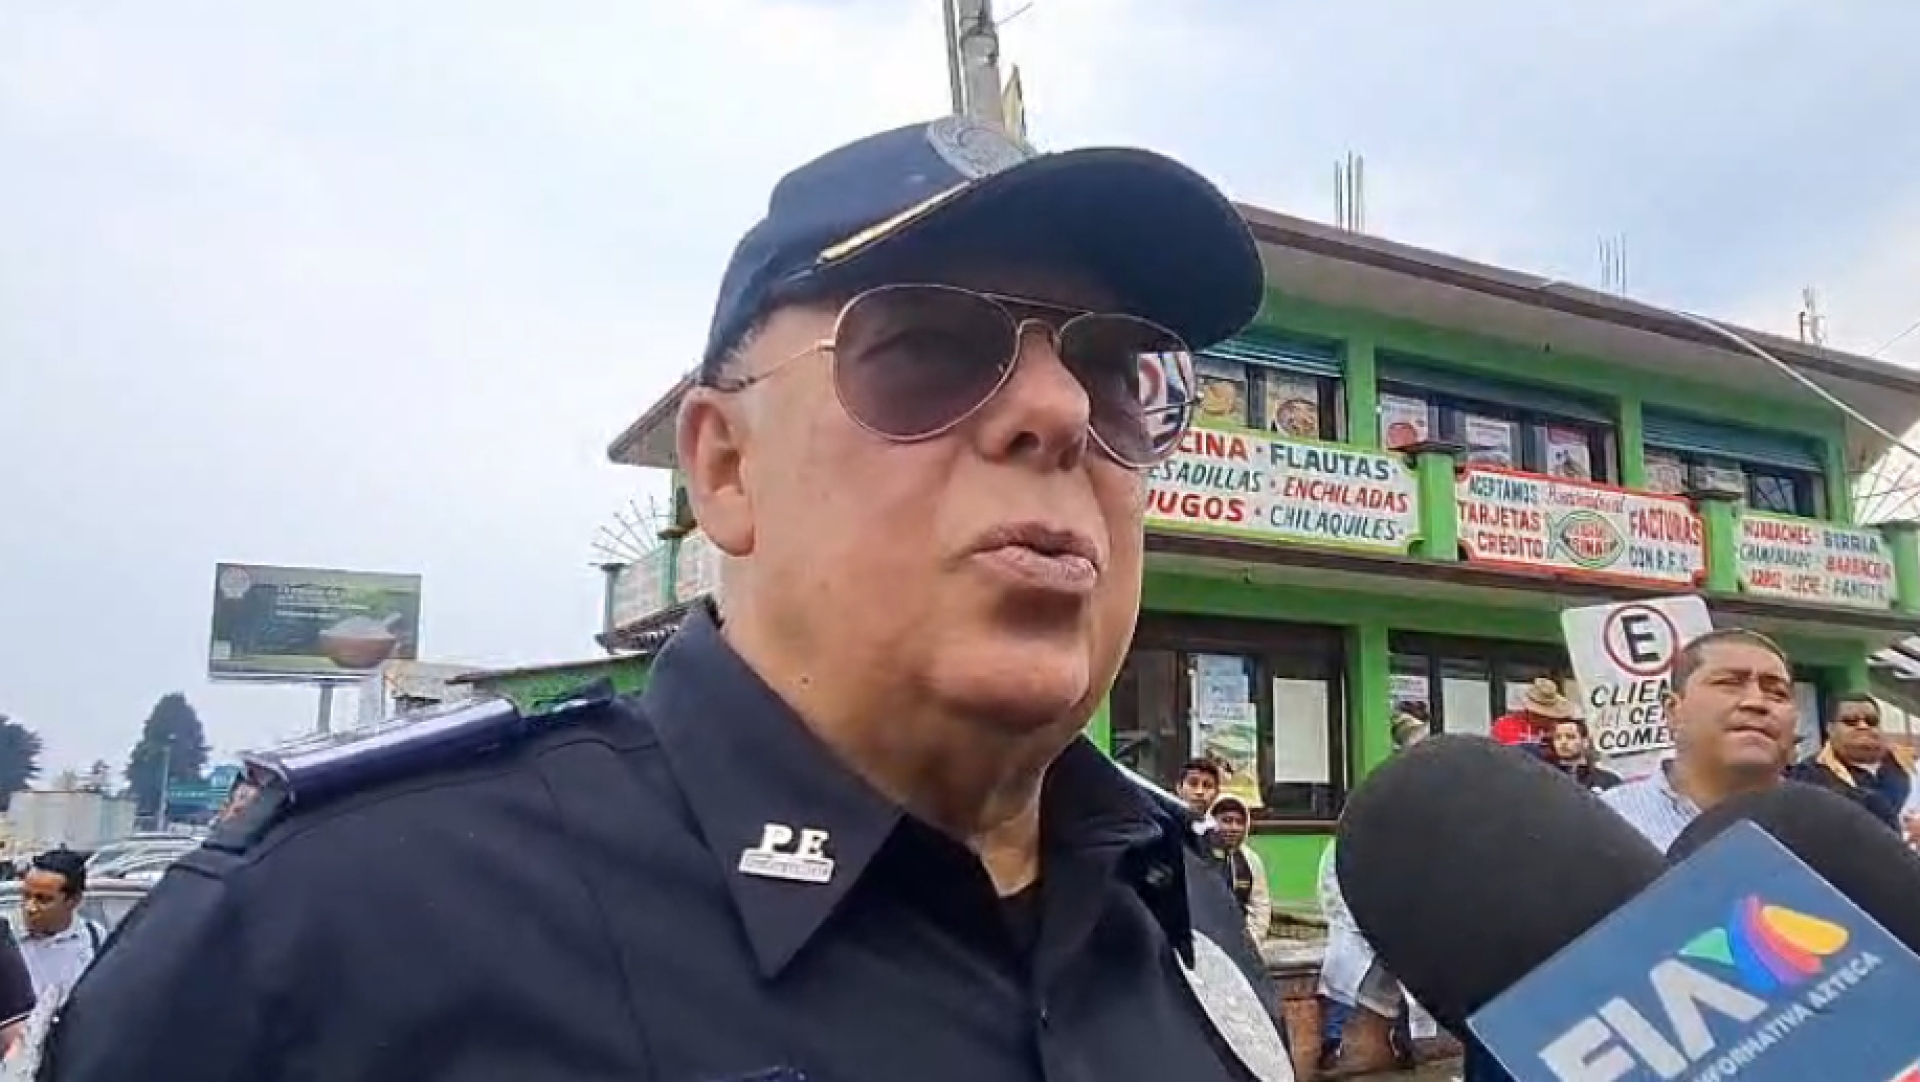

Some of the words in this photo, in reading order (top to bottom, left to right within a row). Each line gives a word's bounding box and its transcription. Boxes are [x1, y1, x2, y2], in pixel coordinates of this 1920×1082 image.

[1270, 443, 1389, 480] FLAUTAS
[1283, 476, 1408, 513] ENCHILADAS
[1469, 475, 1538, 504] ACEPTAMOS
[1270, 505, 1398, 541] CHILAQUILES
[1458, 500, 1541, 532] TARJETAS
[1628, 508, 1700, 546] FACTURAS
[1477, 531, 1544, 560] CREDITO
[1824, 531, 1878, 553] BIRRIA
[1620, 614, 1661, 663] E
[1807, 951, 1883, 1009] AZTECA
